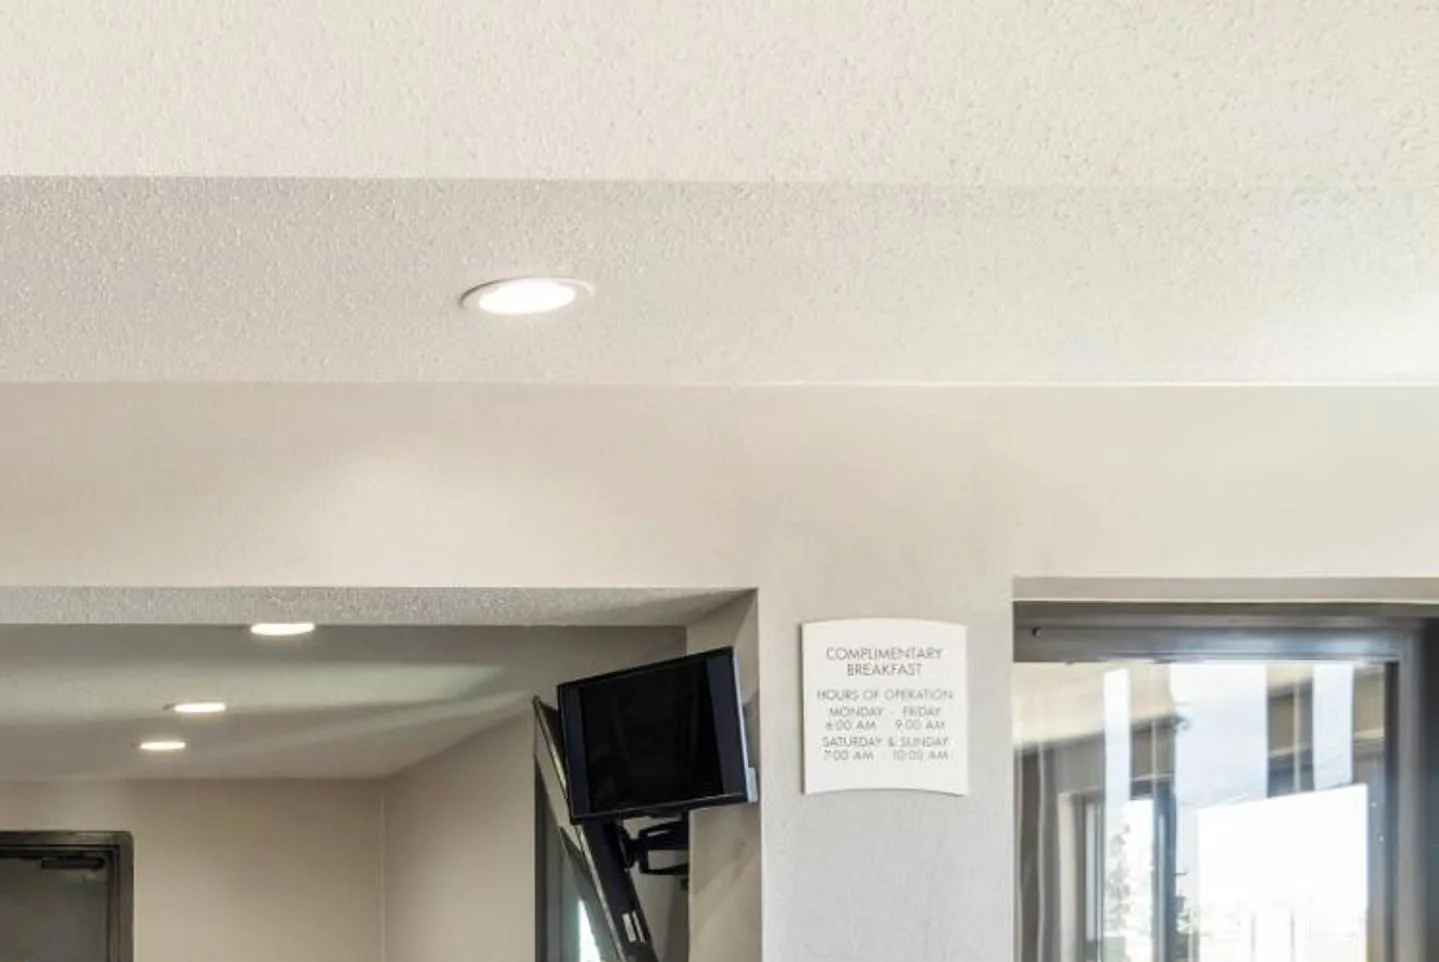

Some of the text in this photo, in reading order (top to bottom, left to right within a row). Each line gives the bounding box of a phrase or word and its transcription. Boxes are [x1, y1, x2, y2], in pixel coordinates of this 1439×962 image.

[825, 646, 944, 661] COMPLIMENTARY
[846, 663, 923, 676] BREAKFAST
[816, 689, 954, 701] HOURS OF OPERATION
[829, 706, 942, 718] MONDAY FRIDAY
[856, 720, 877, 731] AM
[925, 720, 946, 731] AM
[821, 736, 882, 748] SATURDAY
[900, 736, 949, 748] SUNDAY
[852, 750, 874, 761] AM
[927, 750, 949, 761] AM
